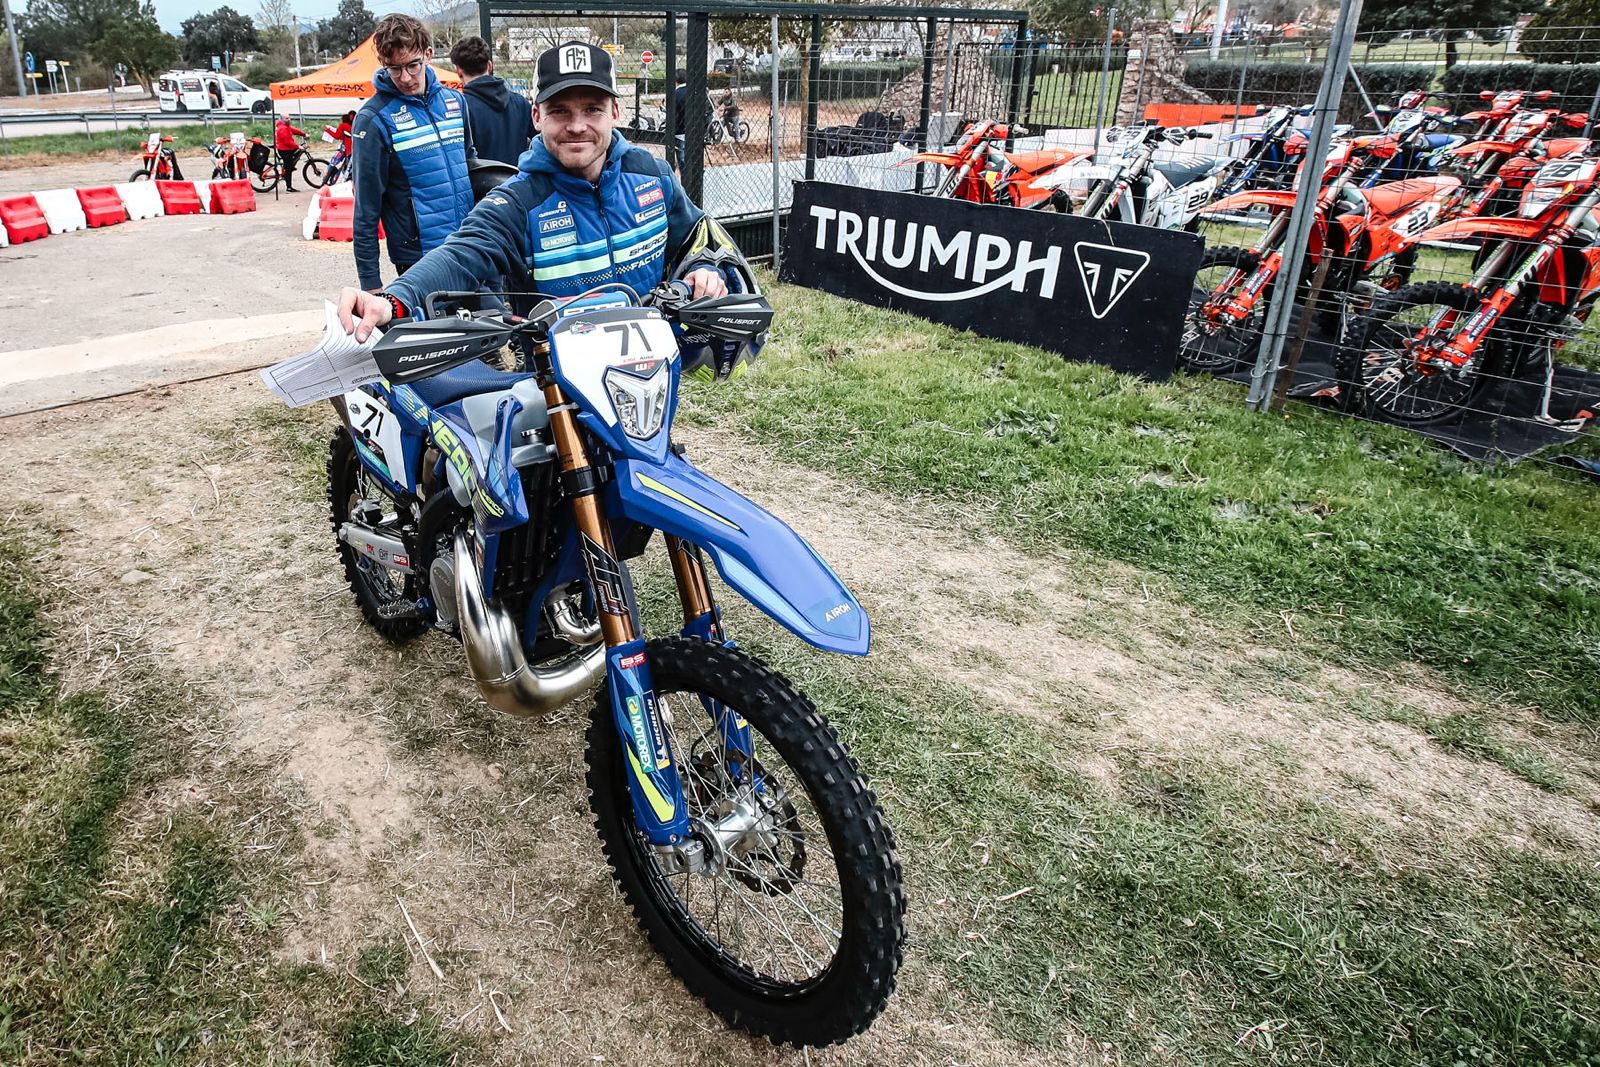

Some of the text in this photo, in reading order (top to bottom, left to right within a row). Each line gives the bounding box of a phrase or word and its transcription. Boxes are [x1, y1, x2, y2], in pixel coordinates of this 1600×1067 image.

[288, 84, 315, 93] 24MX
[334, 84, 364, 92] 24MX
[1540, 164, 1580, 178] 28
[634, 180, 656, 192] KENNY
[638, 190, 660, 204] BS
[1188, 191, 1208, 208] 29
[543, 218, 572, 230] AIROH
[1408, 212, 1428, 232] 23
[631, 248, 665, 270] FACTO
[809, 204, 1062, 300] TRIUMPH
[1472, 308, 1497, 337] MICHELIN
[604, 322, 652, 356] 71
[399, 344, 470, 364] POLISPORT
[360, 402, 384, 438] 71
[825, 604, 852, 623] AIROH
[620, 653, 644, 666] BS
[647, 698, 662, 746] MICHELIN
[630, 714, 653, 770] MOTOREX
